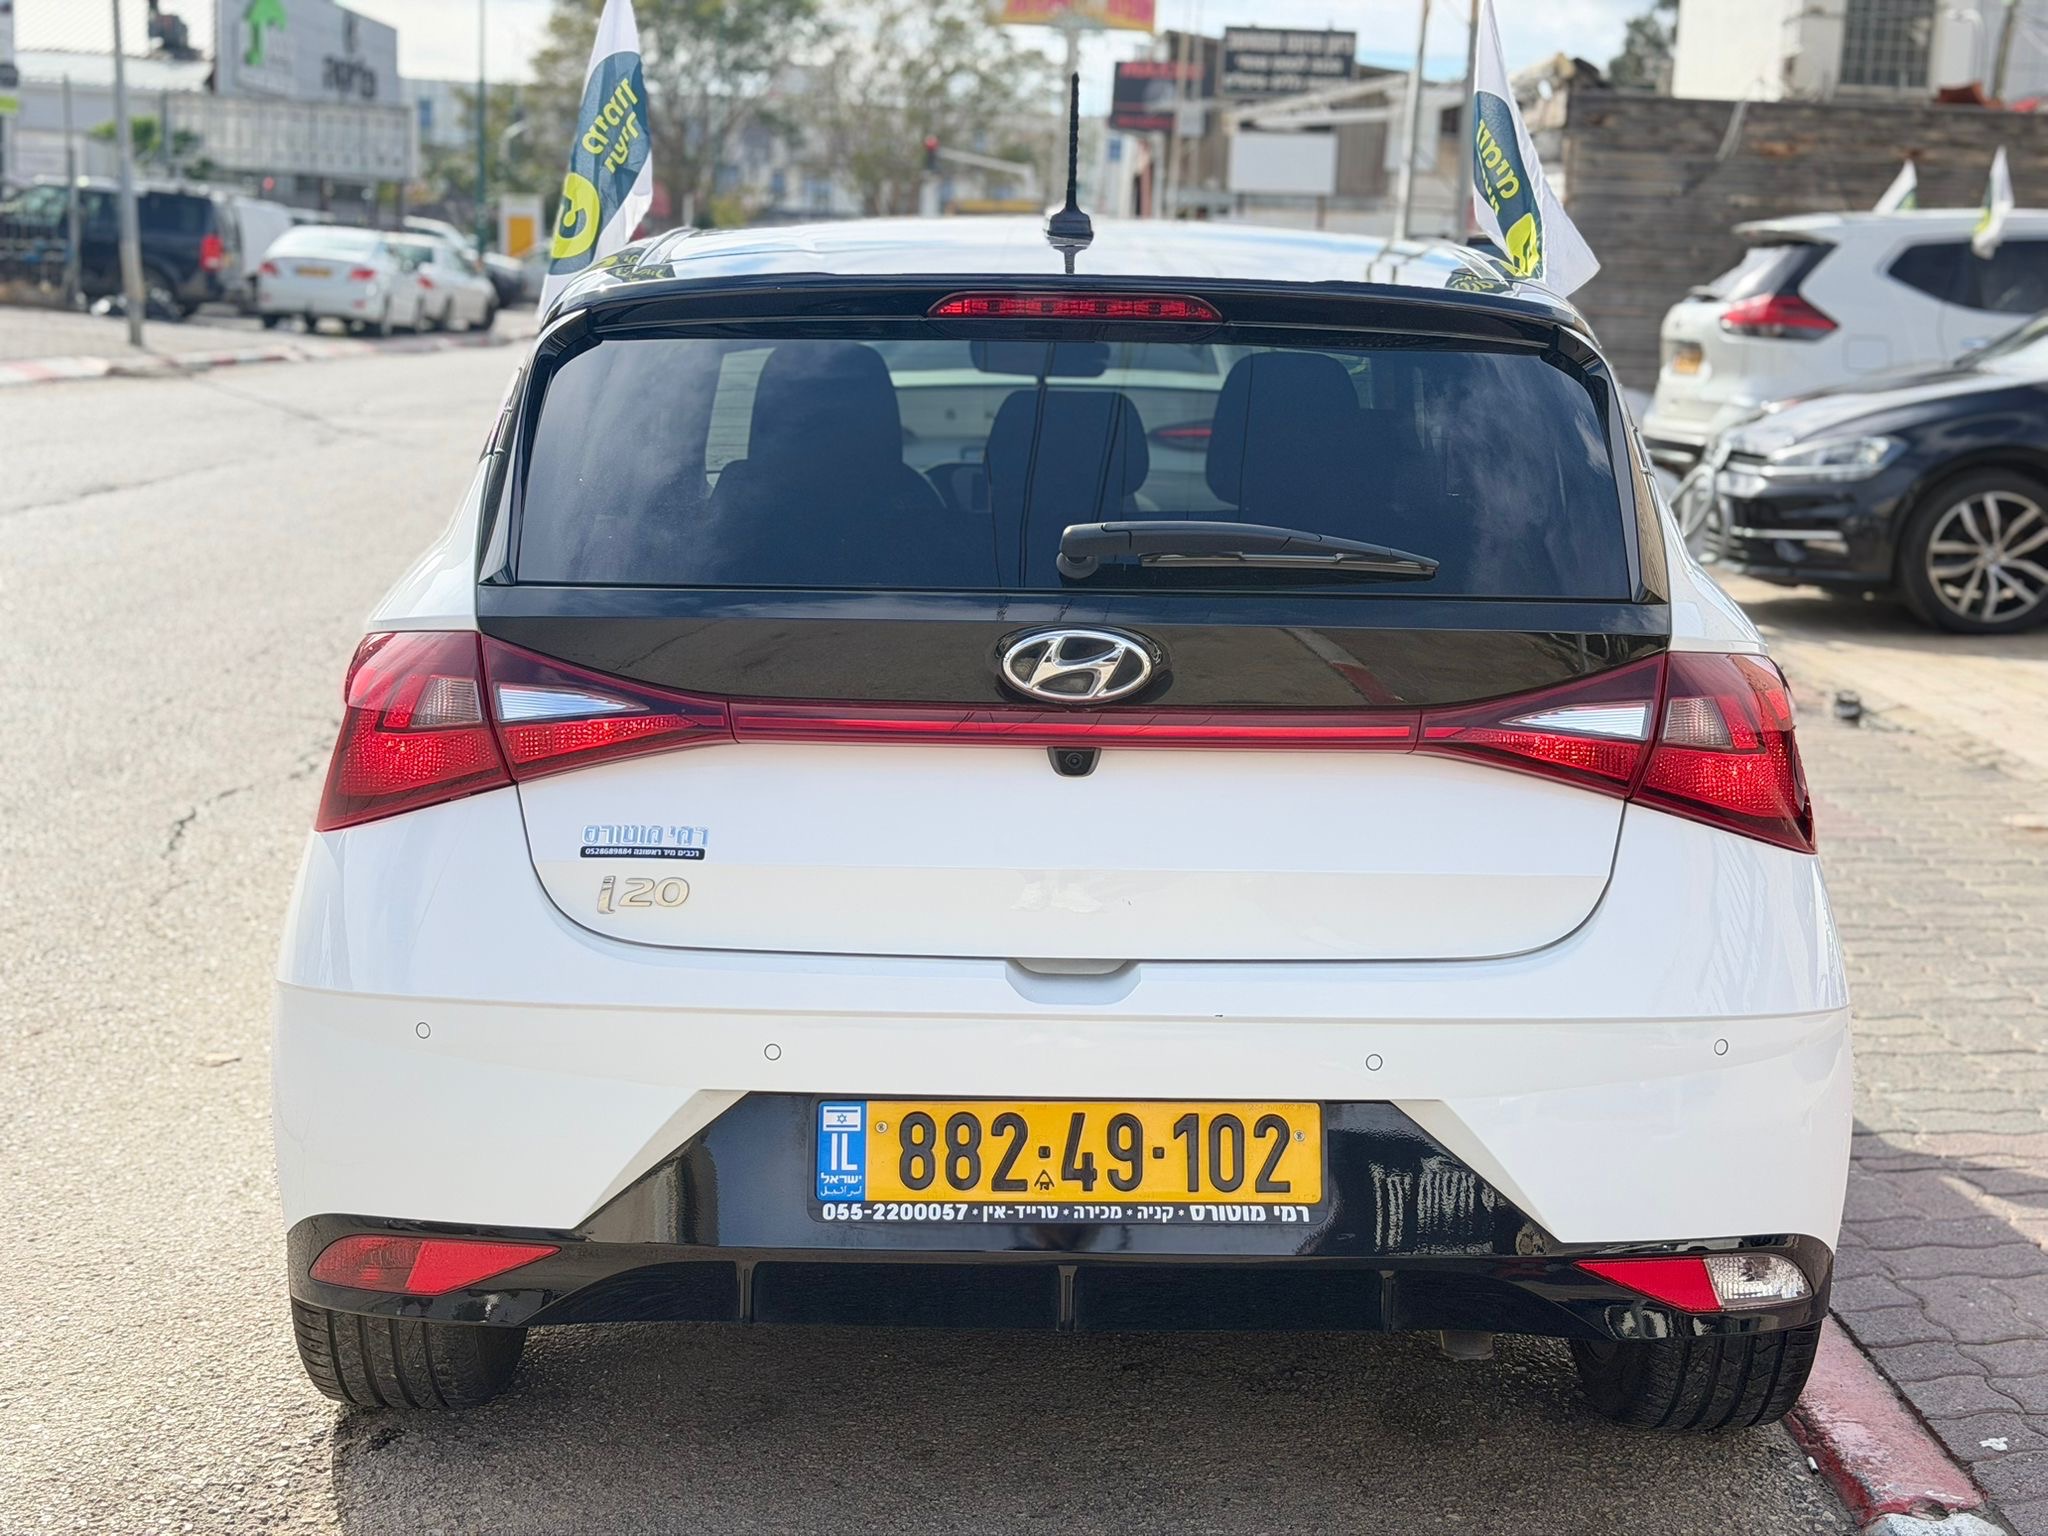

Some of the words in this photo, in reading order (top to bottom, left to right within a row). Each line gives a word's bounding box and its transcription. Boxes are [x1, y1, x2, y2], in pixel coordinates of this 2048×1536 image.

[582, 825, 664, 846] מוטורס
[668, 826, 709, 848] רמי
[597, 875, 690, 914] i20
[831, 1133, 858, 1171] IL
[820, 1172, 862, 1184] ישראל
[822, 1203, 968, 1220] 055-2200057
[982, 1205, 1059, 1222] טרייד-אין
[1073, 1206, 1122, 1219] מכירה
[1137, 1206, 1174, 1223] קניה
[1189, 1205, 1266, 1222] מוטורס
[1273, 1205, 1310, 1222] רמי
